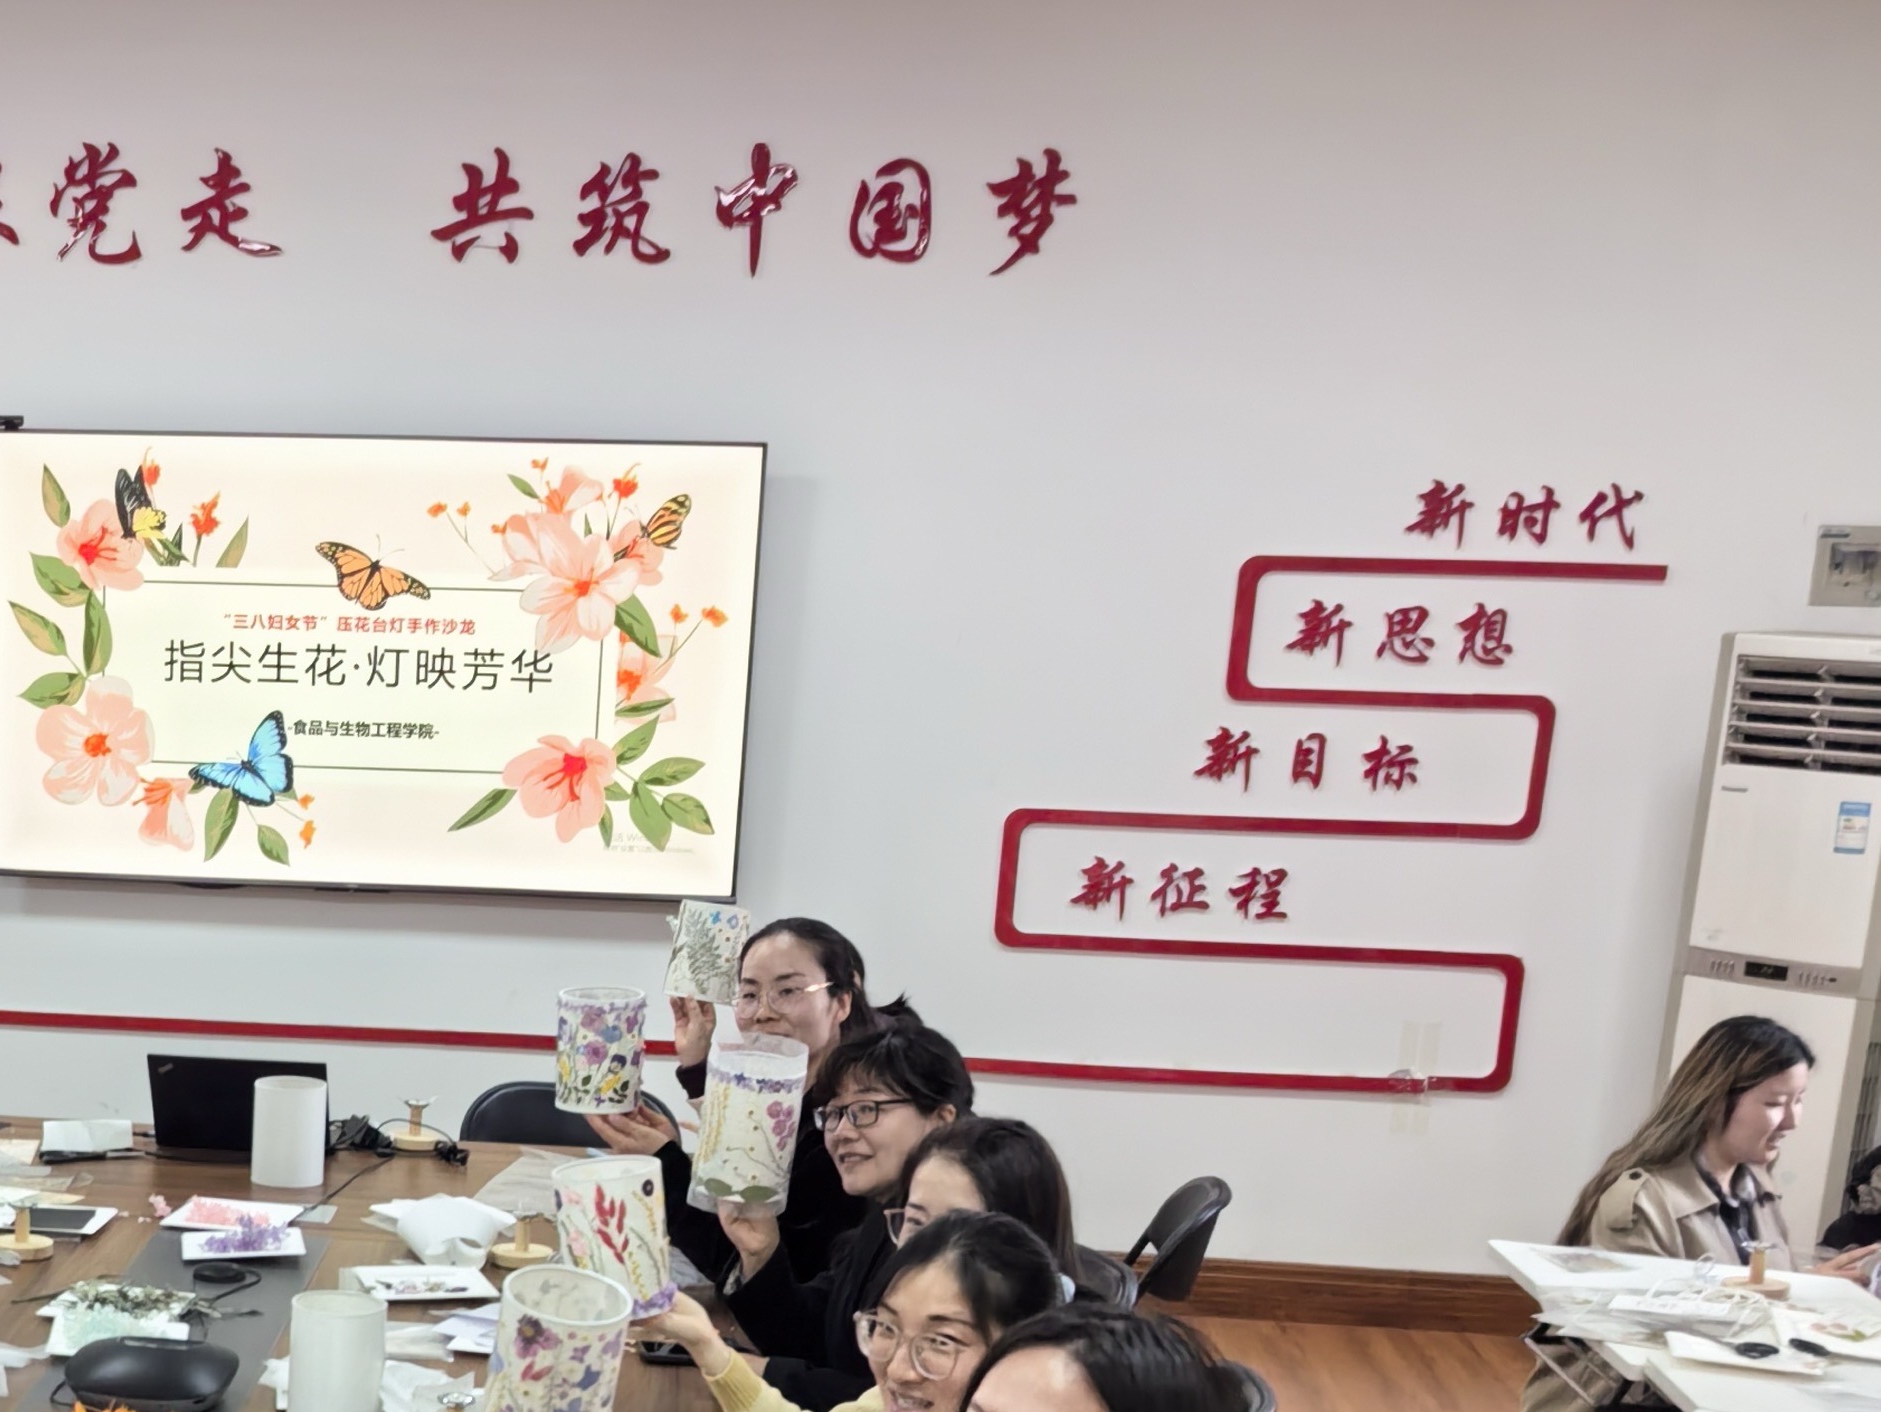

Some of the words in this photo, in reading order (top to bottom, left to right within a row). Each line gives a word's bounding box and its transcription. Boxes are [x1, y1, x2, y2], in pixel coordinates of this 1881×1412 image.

[430, 142, 1079, 275] 共筑中国梦
[1405, 480, 1644, 549] 新时代
[163, 639, 554, 694] 指尖生花·灯映芳华
[1285, 600, 1514, 668] 新思想
[1193, 727, 1421, 793] 新目标
[1069, 857, 1290, 924] 新征程
